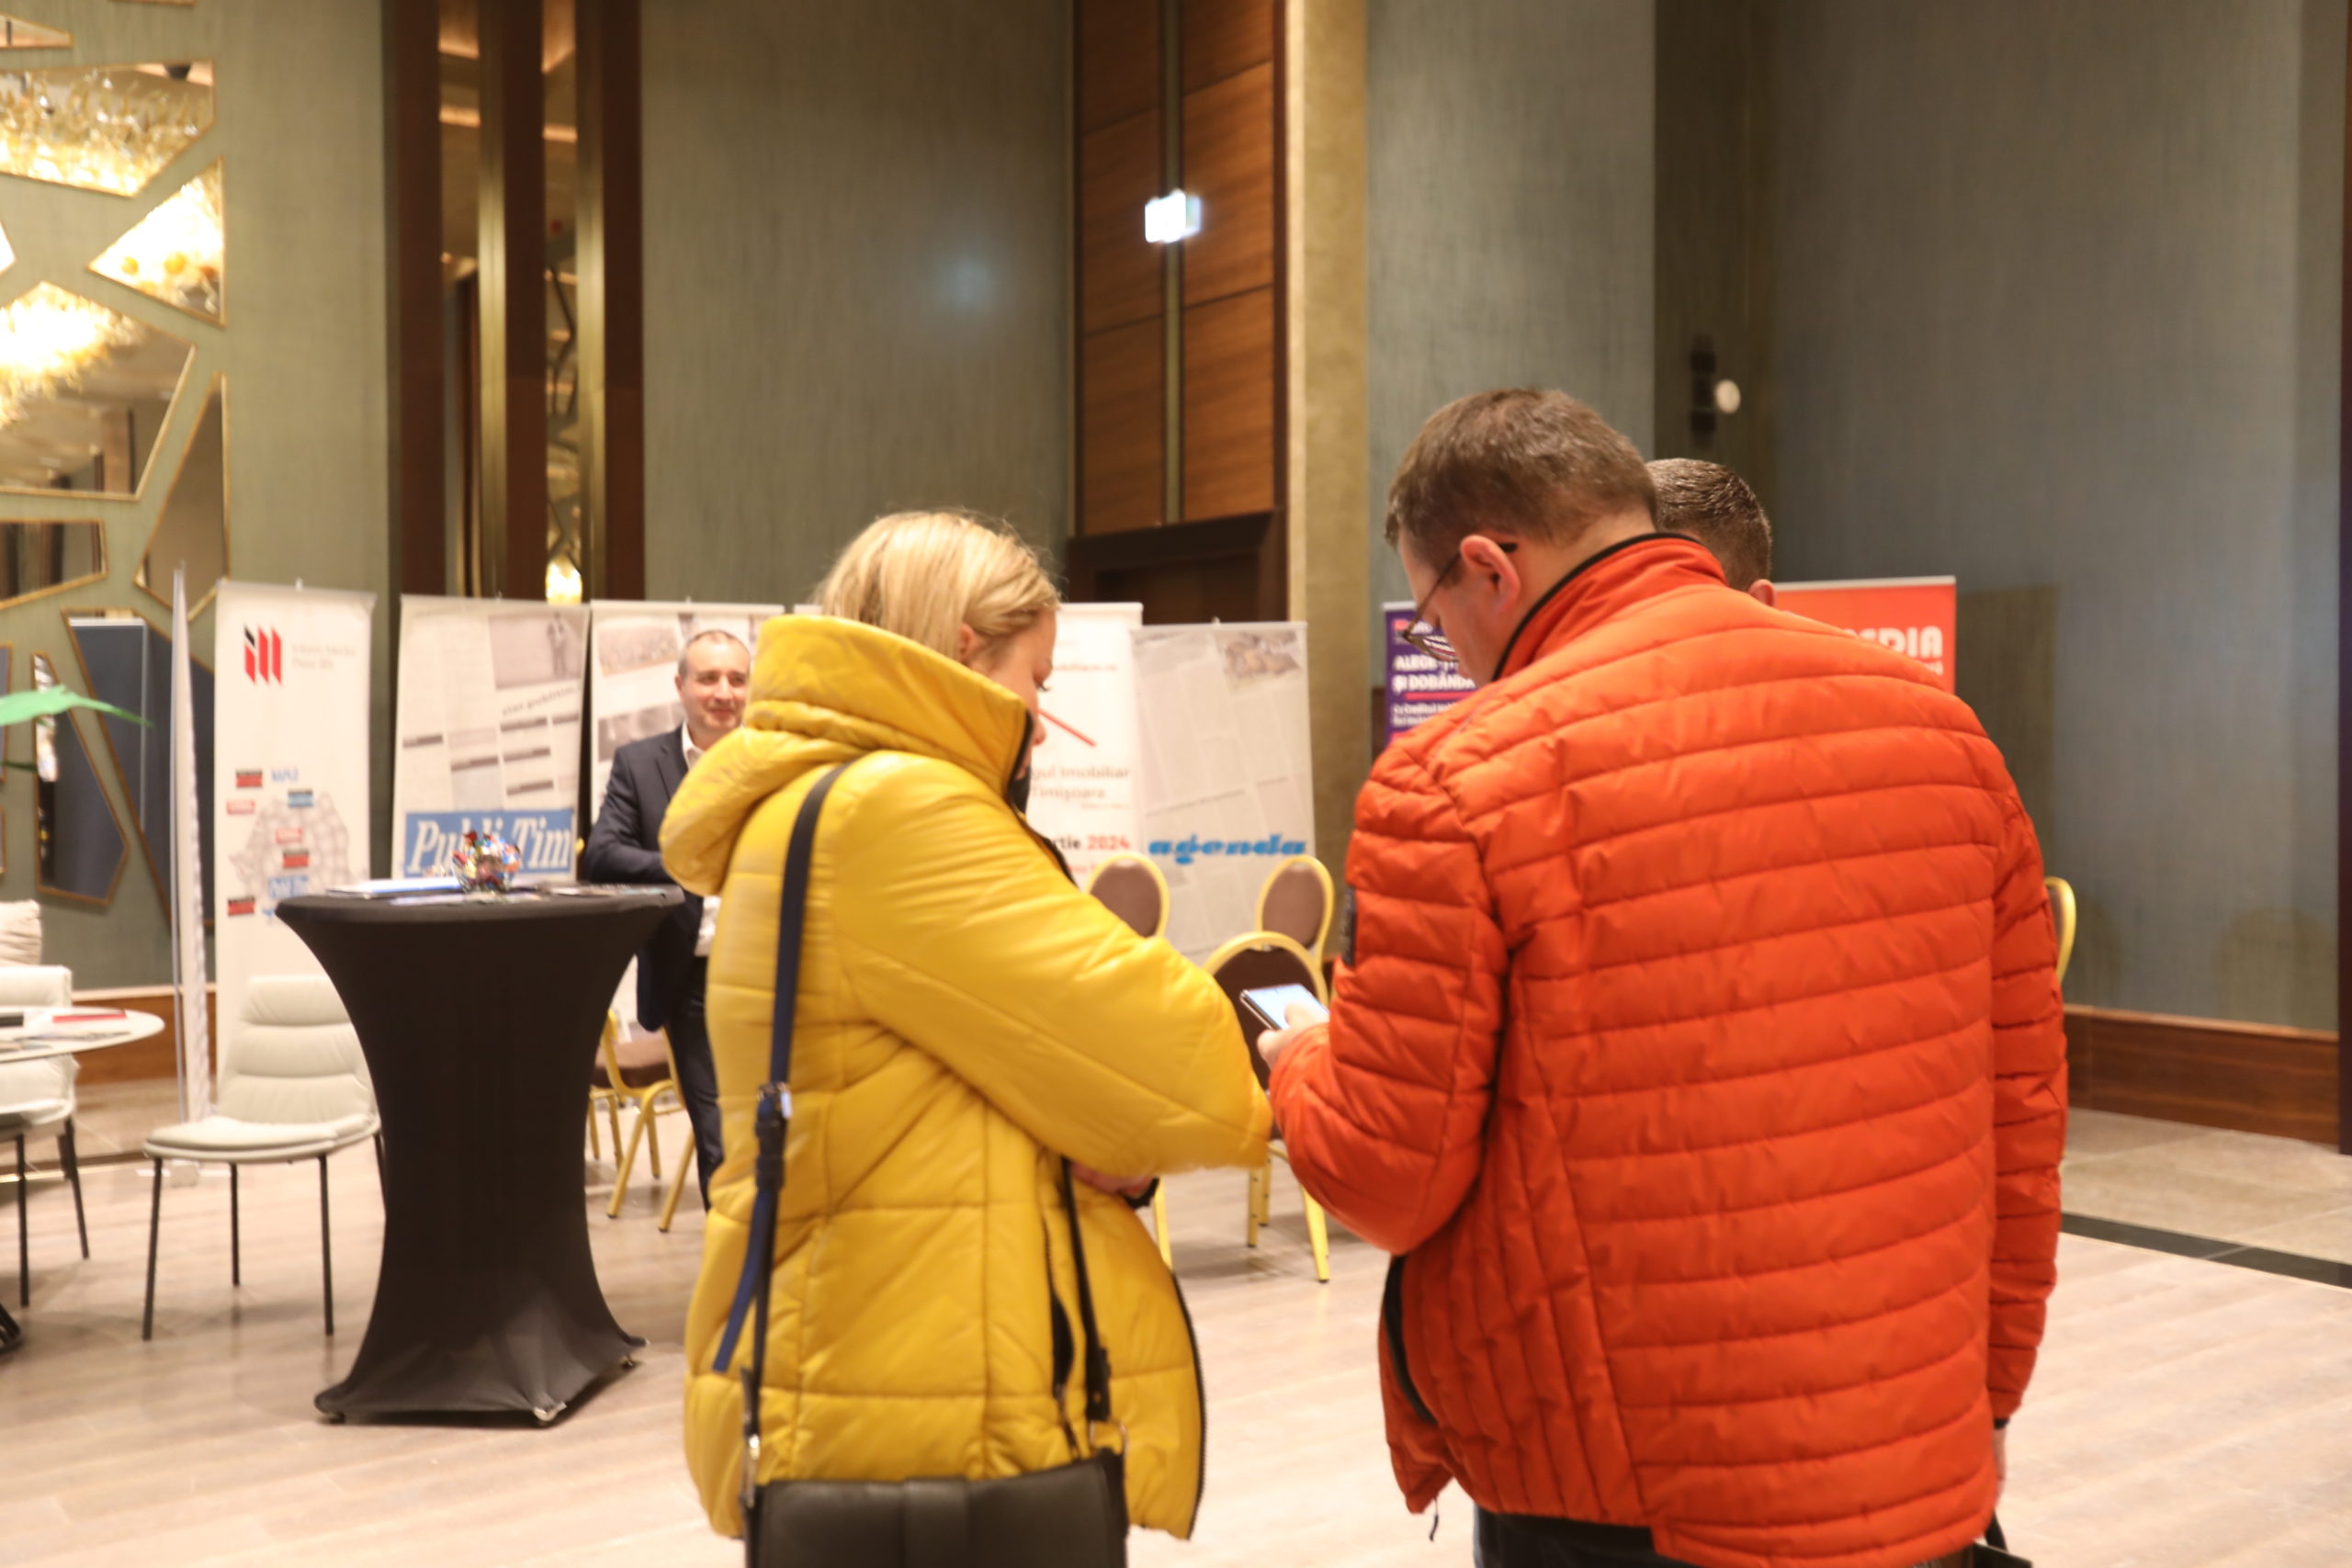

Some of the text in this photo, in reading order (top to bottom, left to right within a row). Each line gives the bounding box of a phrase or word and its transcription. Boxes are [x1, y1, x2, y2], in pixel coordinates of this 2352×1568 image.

[1841, 626, 1943, 659] DIA
[512, 816, 571, 870] Tim
[1087, 834, 1130, 851] 2024
[1148, 833, 1306, 865] agenda
